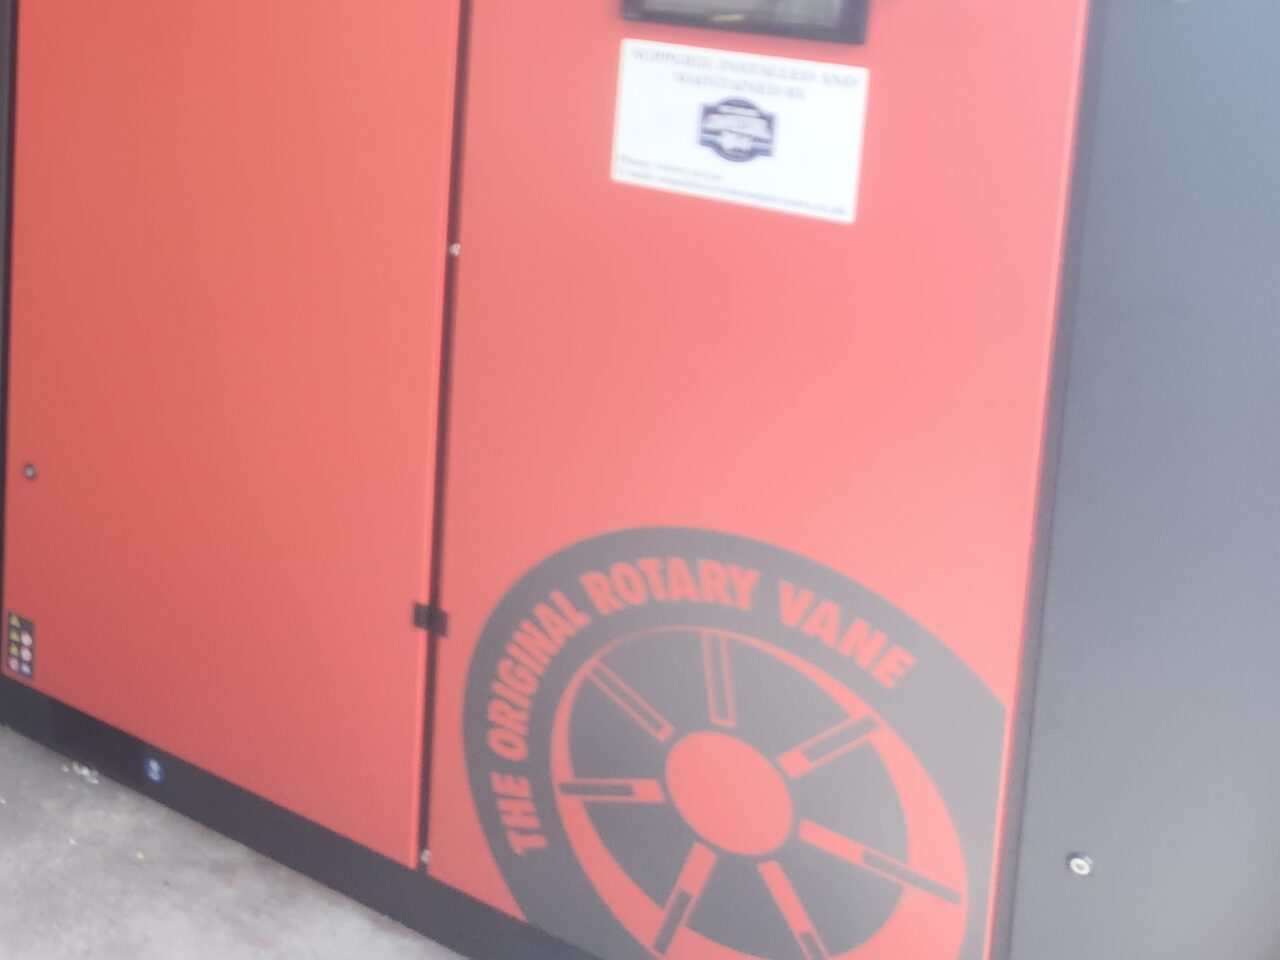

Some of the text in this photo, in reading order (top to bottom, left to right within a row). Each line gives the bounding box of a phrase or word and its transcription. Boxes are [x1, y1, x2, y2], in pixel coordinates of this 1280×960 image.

[487, 556, 918, 857] THE ORIGINAL ROTARY VANE
